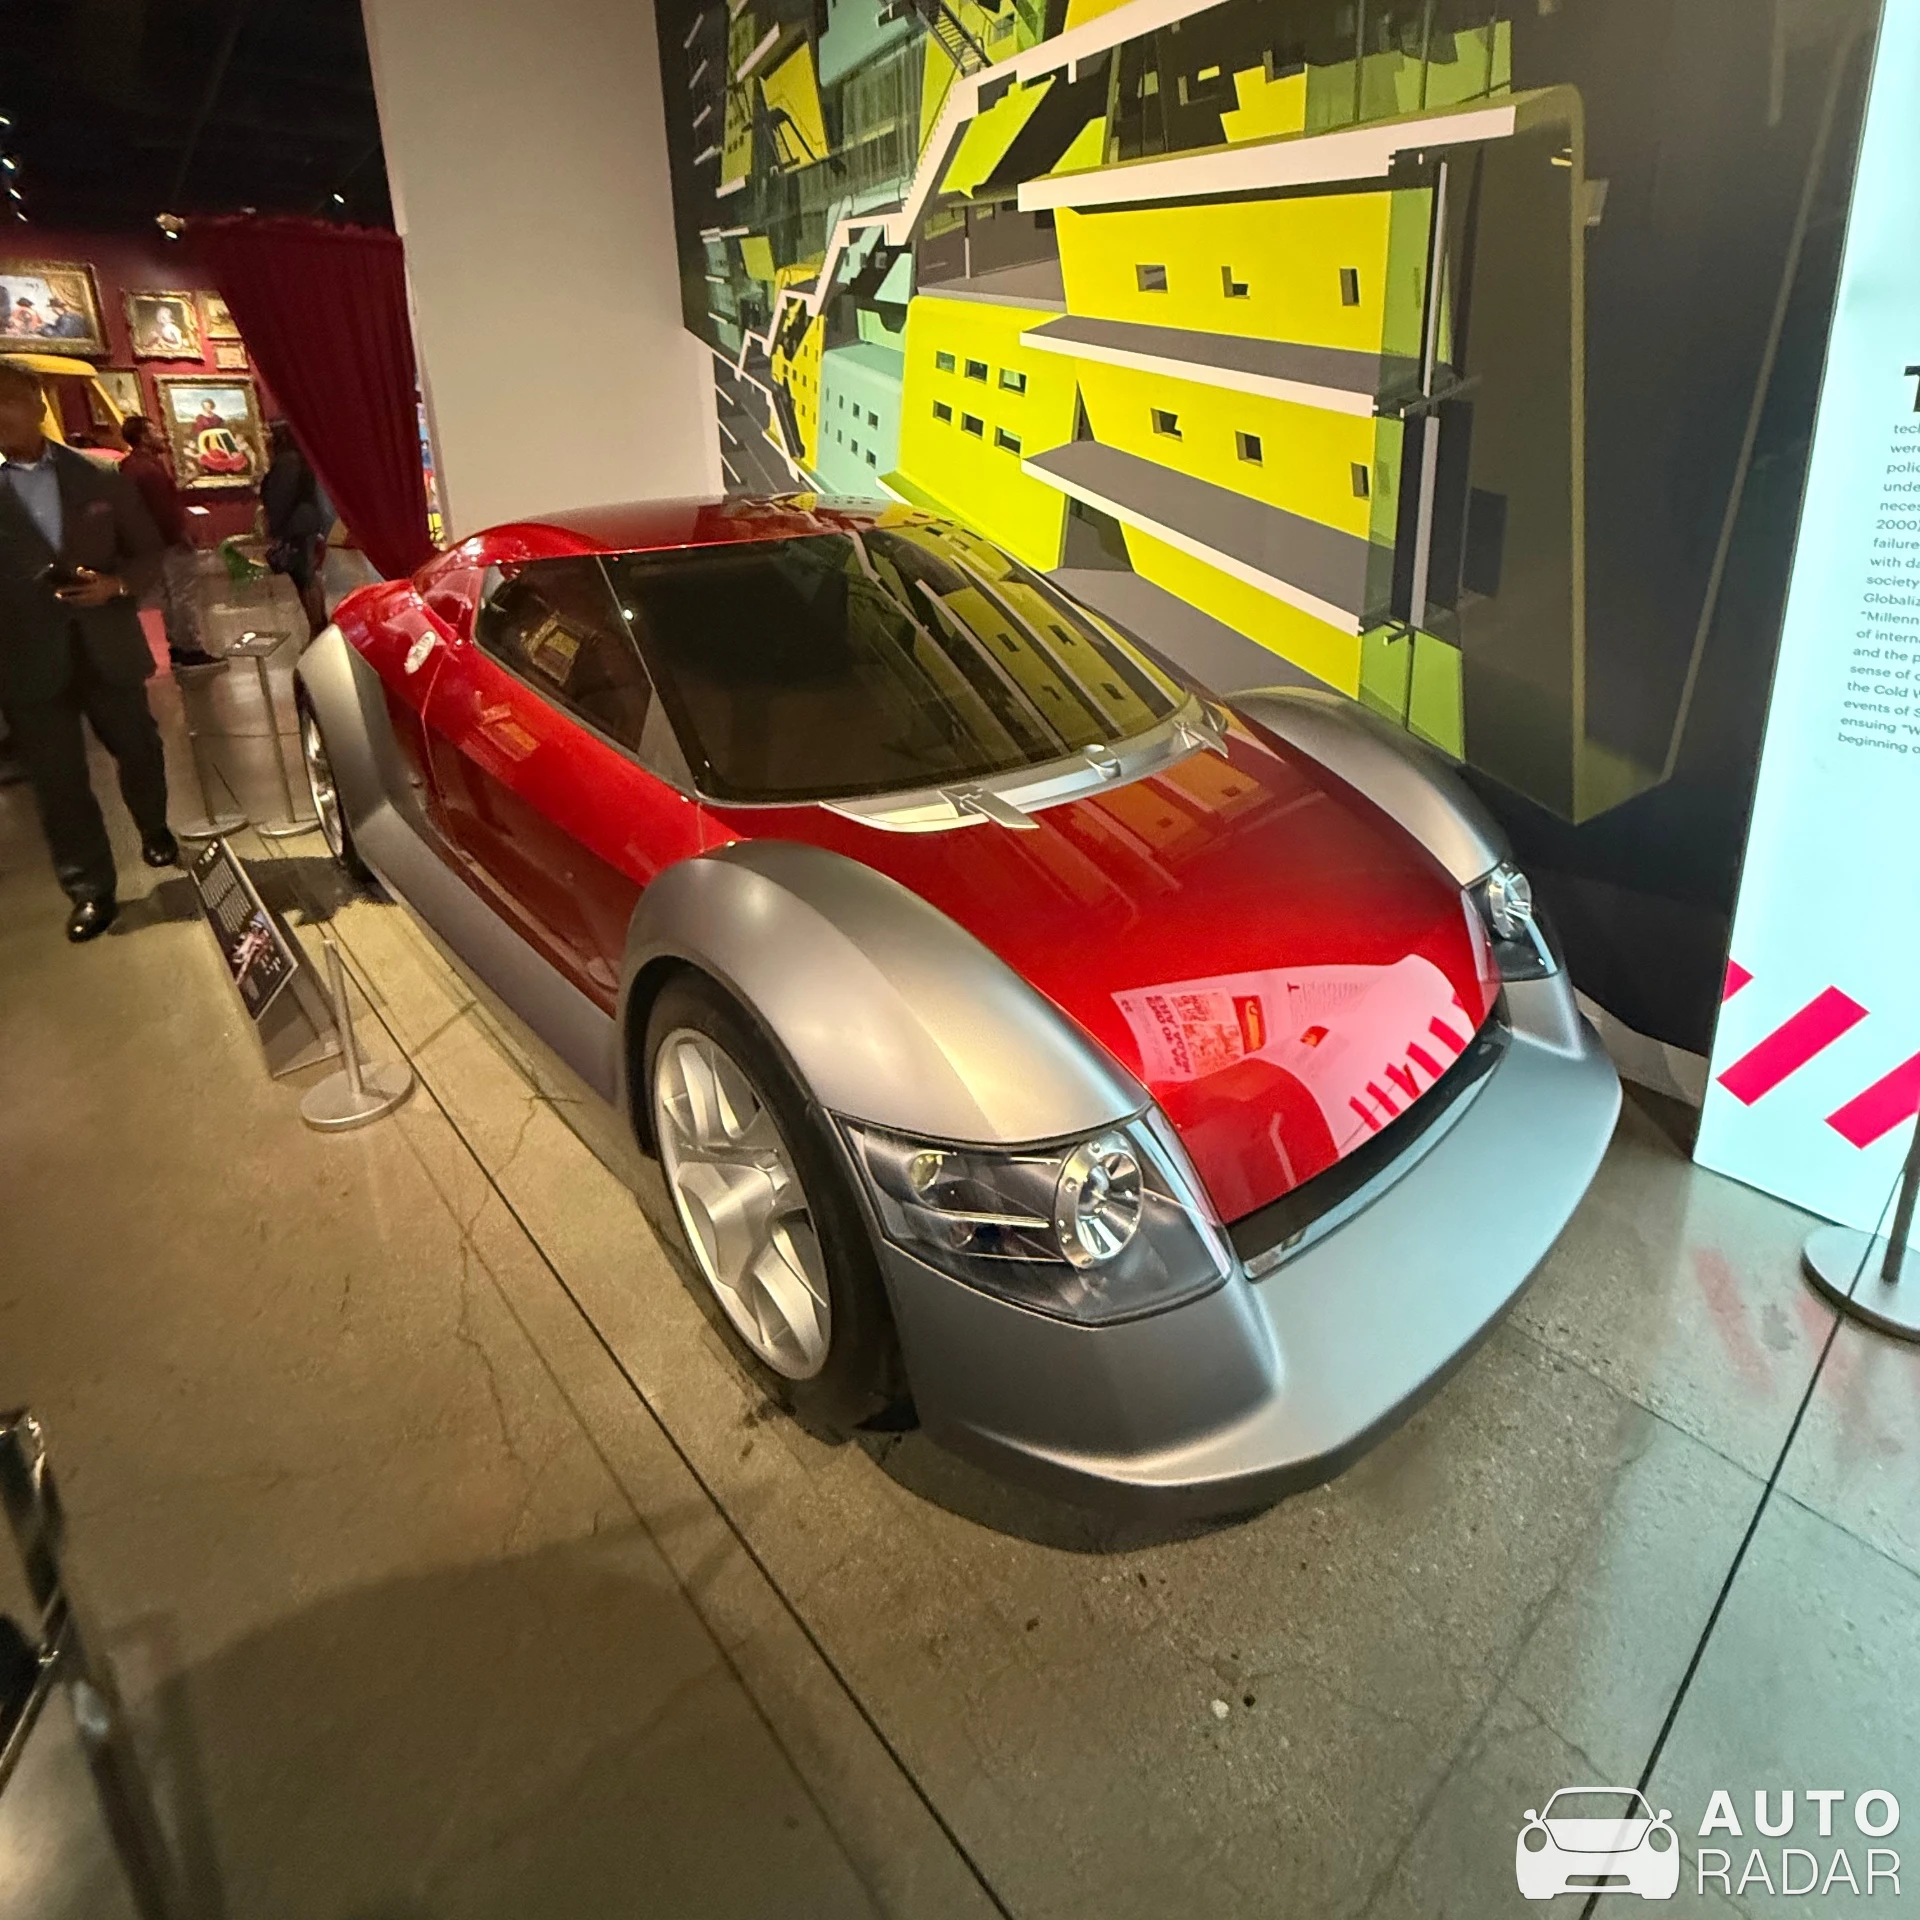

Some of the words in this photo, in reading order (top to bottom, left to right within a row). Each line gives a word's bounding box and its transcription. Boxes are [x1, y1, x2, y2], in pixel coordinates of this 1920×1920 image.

[1894, 423, 1920, 435] tec
[1883, 481, 1920, 493] unde
[1873, 537, 1920, 550] failure
[1870, 556, 1901, 568] with
[1866, 575, 1920, 590] society
[1856, 628, 1872, 639] of
[1875, 630, 1920, 645] intern
[1853, 647, 1880, 659] and
[1884, 649, 1908, 662] the
[1850, 665, 1891, 678] sense
[1895, 668, 1911, 680] of
[1847, 681, 1870, 693] the
[1874, 684, 1908, 698] Cold
[1843, 700, 1890, 714] events
[1894, 706, 1910, 717] of
[1840, 717, 1897, 734] ensuing
[1837, 732, 1908, 754] beginning
